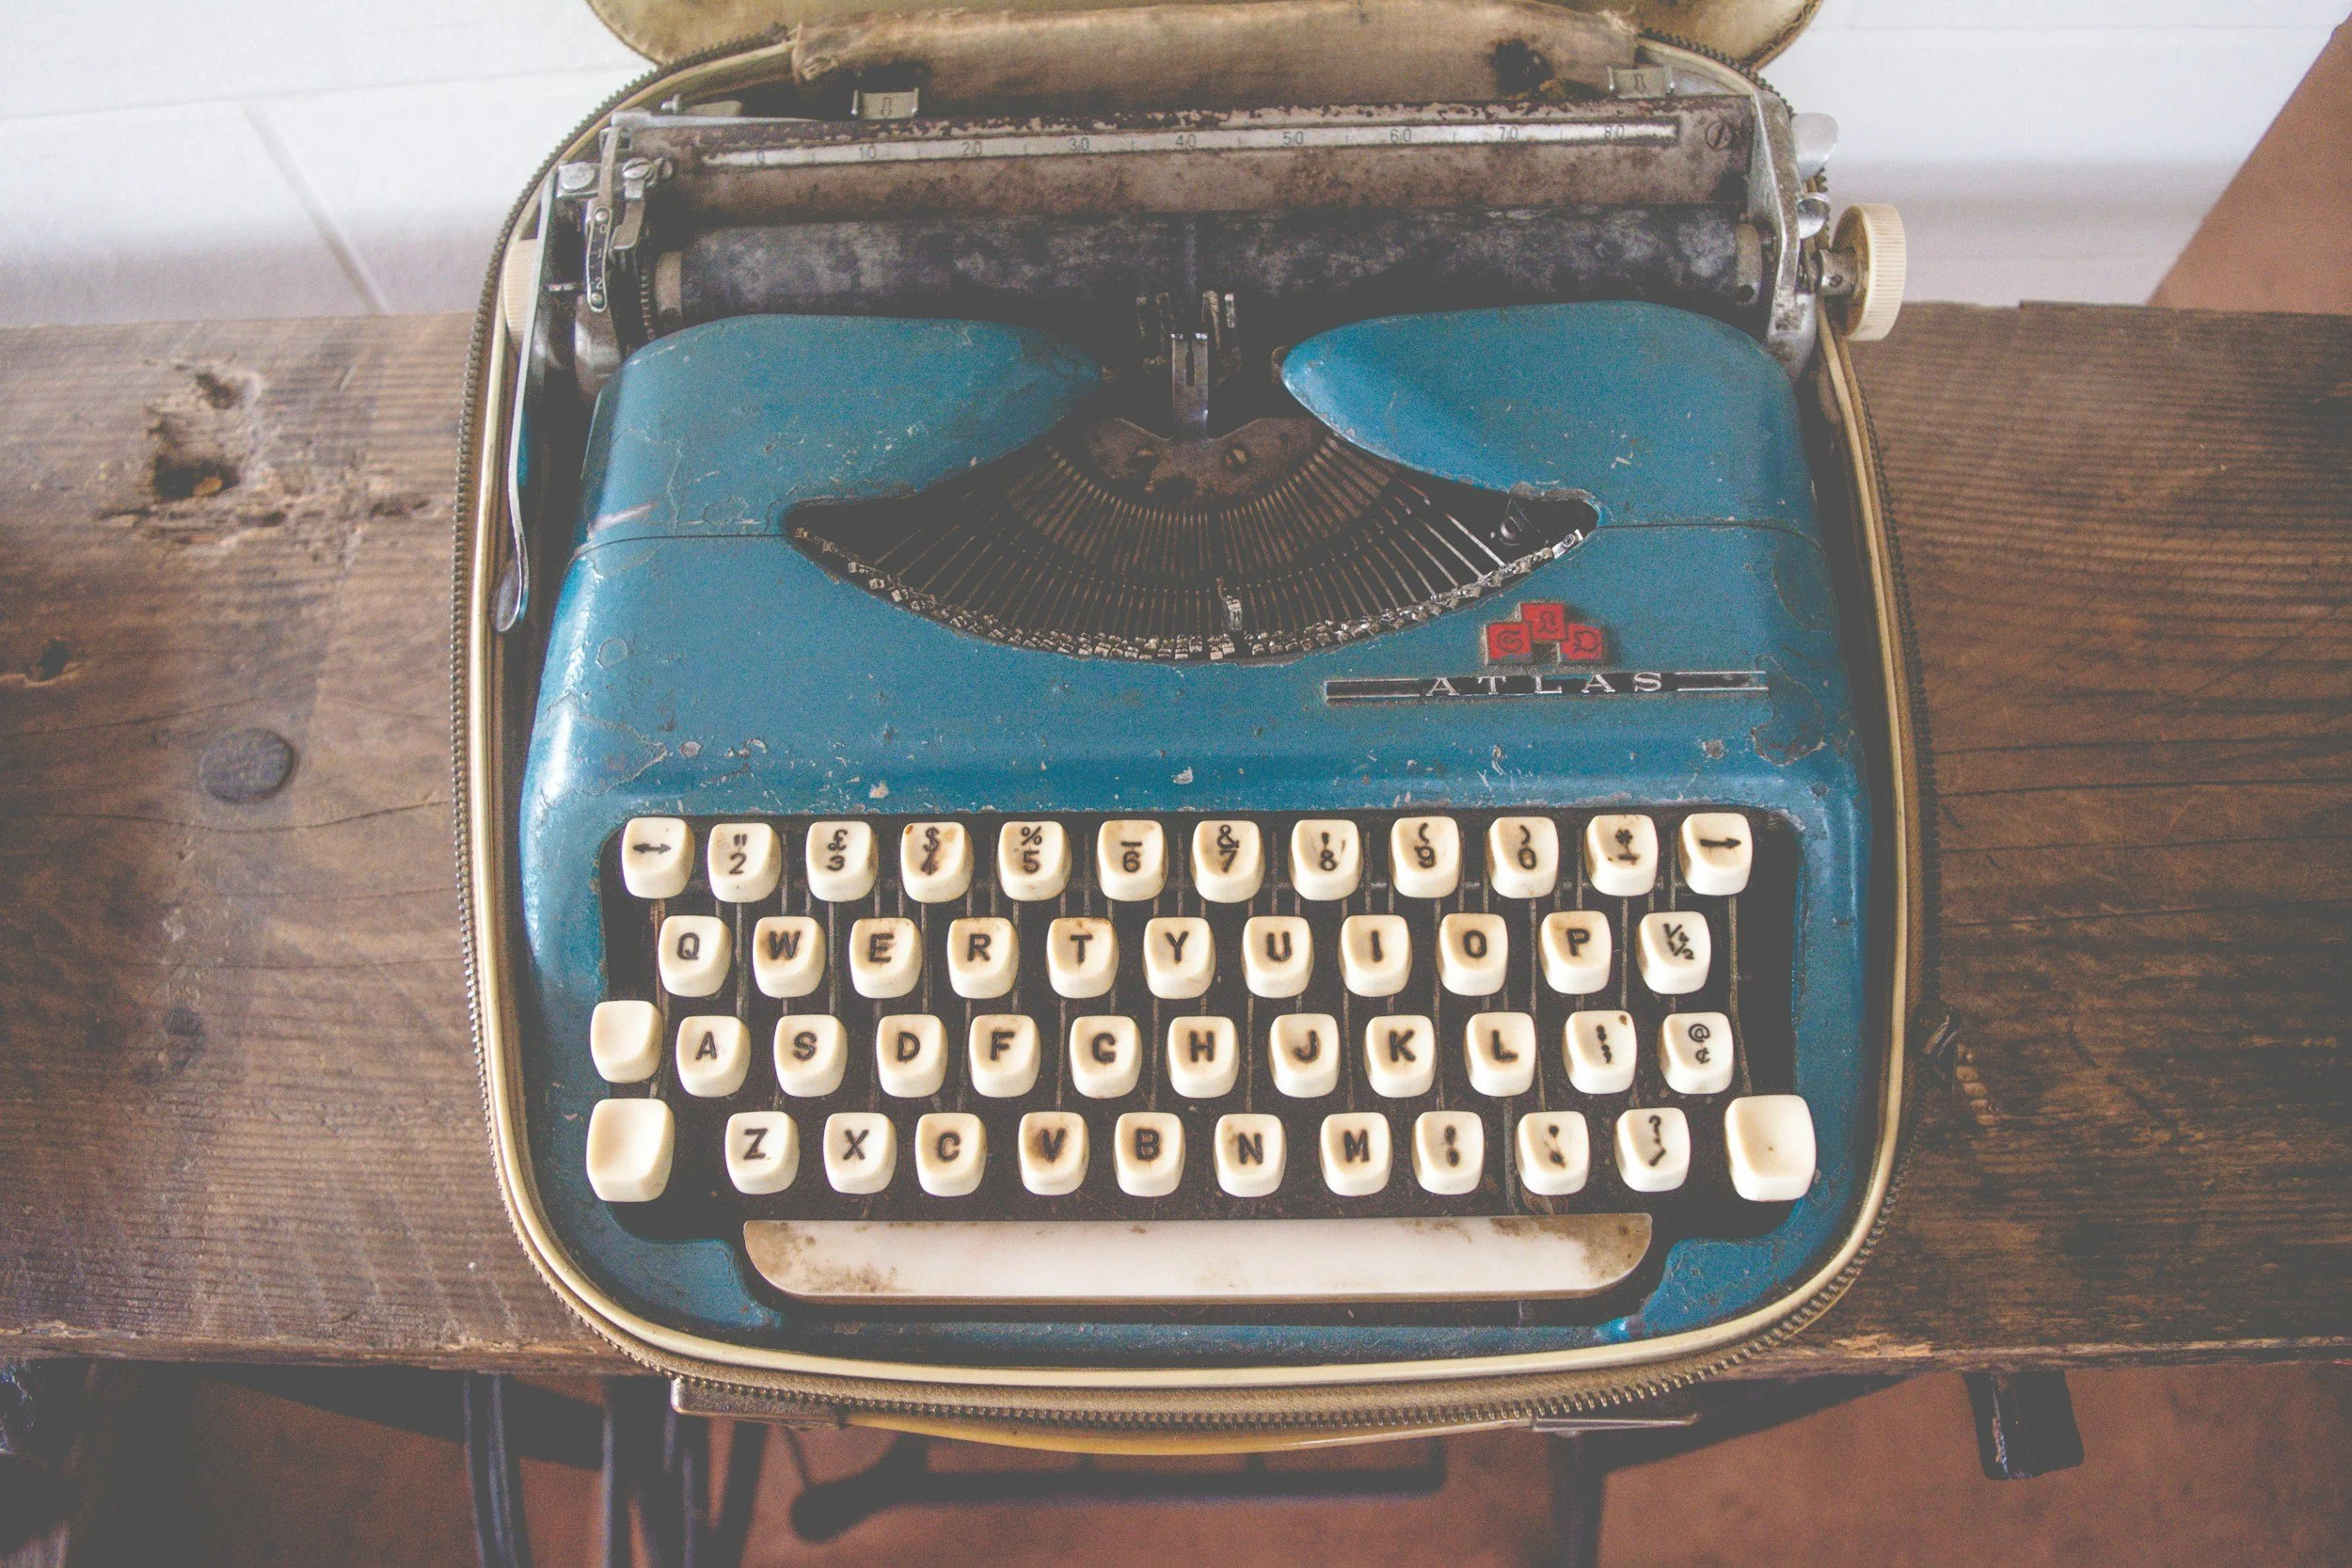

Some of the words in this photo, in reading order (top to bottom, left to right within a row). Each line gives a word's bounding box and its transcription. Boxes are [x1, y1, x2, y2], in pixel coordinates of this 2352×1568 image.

[858, 143, 877, 160] 10
[961, 140, 982, 156] 20
[1069, 136, 1090, 151] 30
[1175, 134, 1197, 150] 40
[1283, 130, 1304, 146] 50
[1390, 127, 1412, 143] 60
[1498, 125, 1519, 140] 70
[1603, 123, 1626, 140] 80
[1425, 672, 1662, 697] ATLAS
[728, 851, 747, 875] 2
[826, 854, 845, 872] 3
[1022, 848, 1041, 875] 5
[1121, 849, 1141, 874] 6
[1218, 846, 1240, 874] 7
[1318, 848, 1338, 872] 8
[675, 932, 700, 961] Q
[767, 930, 802, 961] W
[867, 932, 895, 963] E
[966, 932, 992, 962] R
[1068, 932, 1093, 966] T
[1164, 930, 1189, 964] Y
[1265, 931, 1293, 963] U
[1369, 929, 1384, 963] I
[1461, 929, 1487, 959] O
[1565, 927, 1591, 958] P
[694, 1030, 718, 1061] A
[791, 1031, 818, 1062] S
[896, 1030, 921, 1063] D
[989, 1028, 1016, 1062] F
[1090, 1032, 1117, 1066] G
[1187, 1030, 1216, 1064] H
[1294, 1029, 1319, 1063] J
[1387, 1029, 1416, 1063] K
[1489, 1029, 1518, 1064] L
[1688, 1022, 1710, 1044] @
[742, 1127, 769, 1161] Z
[842, 1129, 869, 1161] X
[935, 1132, 961, 1163] C
[1040, 1128, 1067, 1164] V
[1132, 1127, 1161, 1163] B
[1235, 1132, 1264, 1165] N
[1342, 1129, 1371, 1164] M
